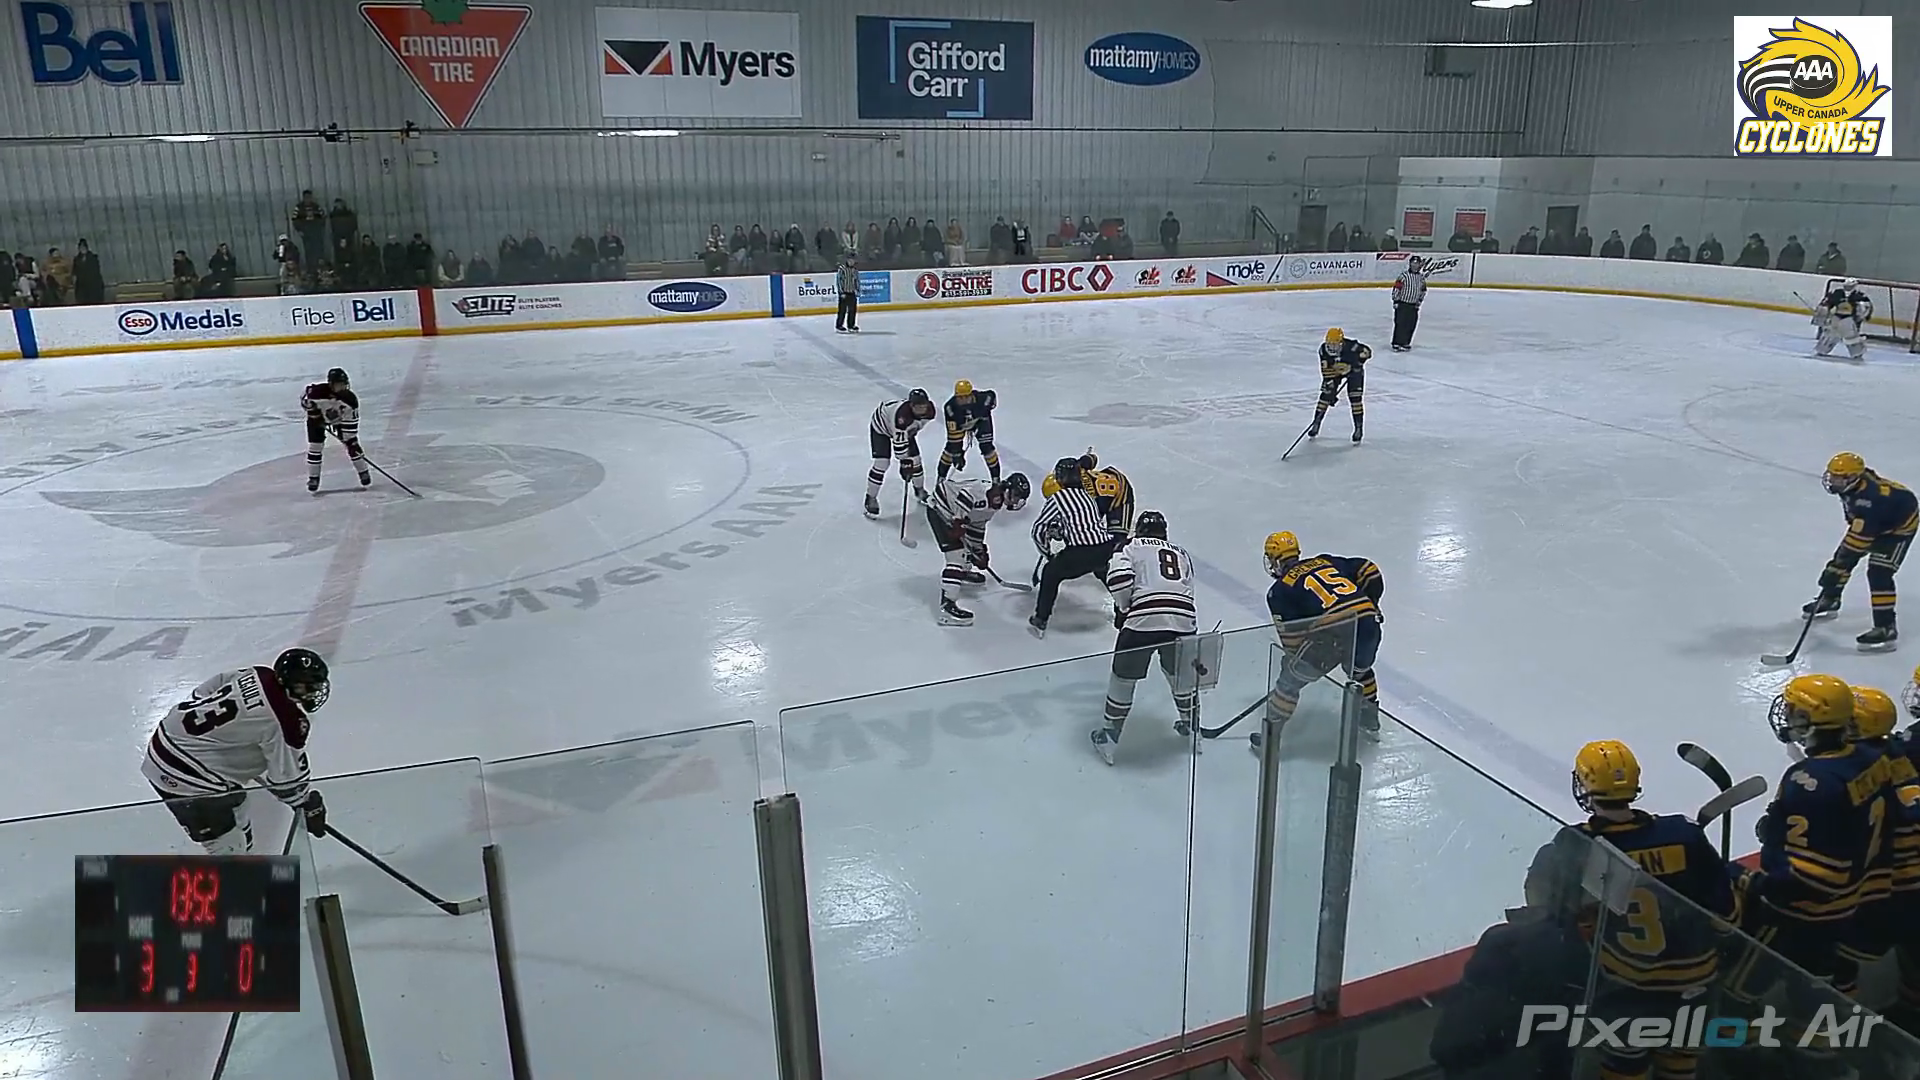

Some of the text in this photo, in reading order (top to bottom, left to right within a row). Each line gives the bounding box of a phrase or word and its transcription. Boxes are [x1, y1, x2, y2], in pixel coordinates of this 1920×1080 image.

[20, 0, 183, 85] Bell
[401, 36, 499, 58] CANADIAN
[680, 41, 796, 85] Myers
[907, 42, 1006, 72] Gifford
[430, 62, 474, 83] TIRE
[907, 71, 968, 98] Carr
[1227, 260, 1265, 278] move
[1309, 260, 1363, 269] CAVANAGH
[942, 276, 992, 290] CENTRE
[1021, 266, 1085, 294] CIBC
[292, 307, 336, 326] Fibe
[352, 298, 395, 322] Bell
[465, 297, 514, 312] ELITE
[160, 308, 244, 331] Medals
[446, 483, 822, 627] Myers AAA
[1158, 549, 1181, 580] 8
[1303, 567, 1357, 609] 15
[1787, 815, 1808, 848] 2
[1616, 887, 1666, 957] 3
